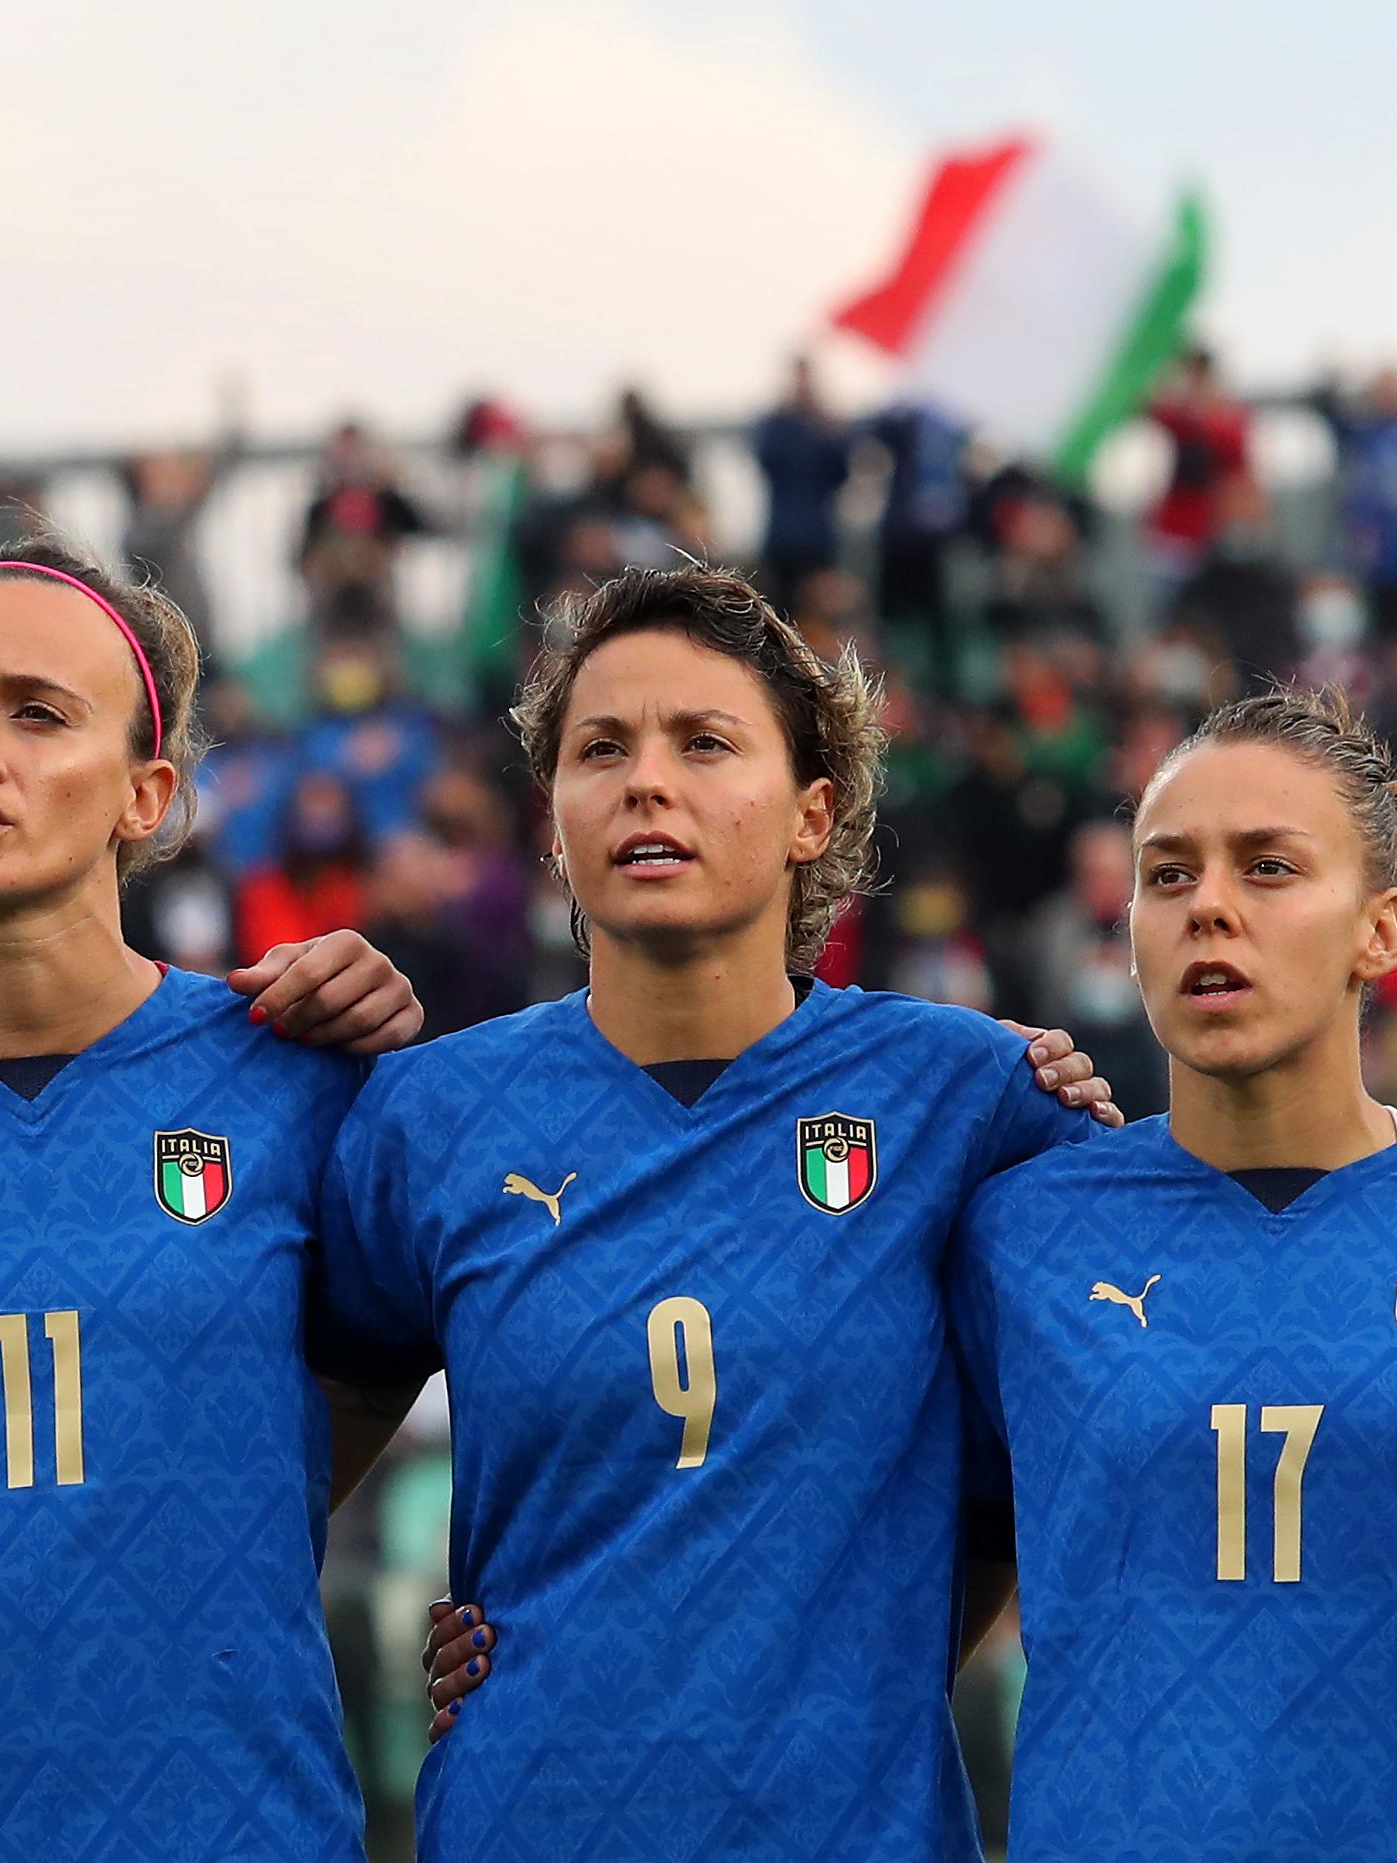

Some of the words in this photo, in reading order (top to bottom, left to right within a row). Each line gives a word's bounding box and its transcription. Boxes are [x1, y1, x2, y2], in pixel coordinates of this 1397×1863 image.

[161, 1139, 221, 1156] ITALIA
[805, 1123, 867, 1140] ITALIA
[647, 1295, 717, 1470] 9
[1209, 1403, 1326, 1584] 17
